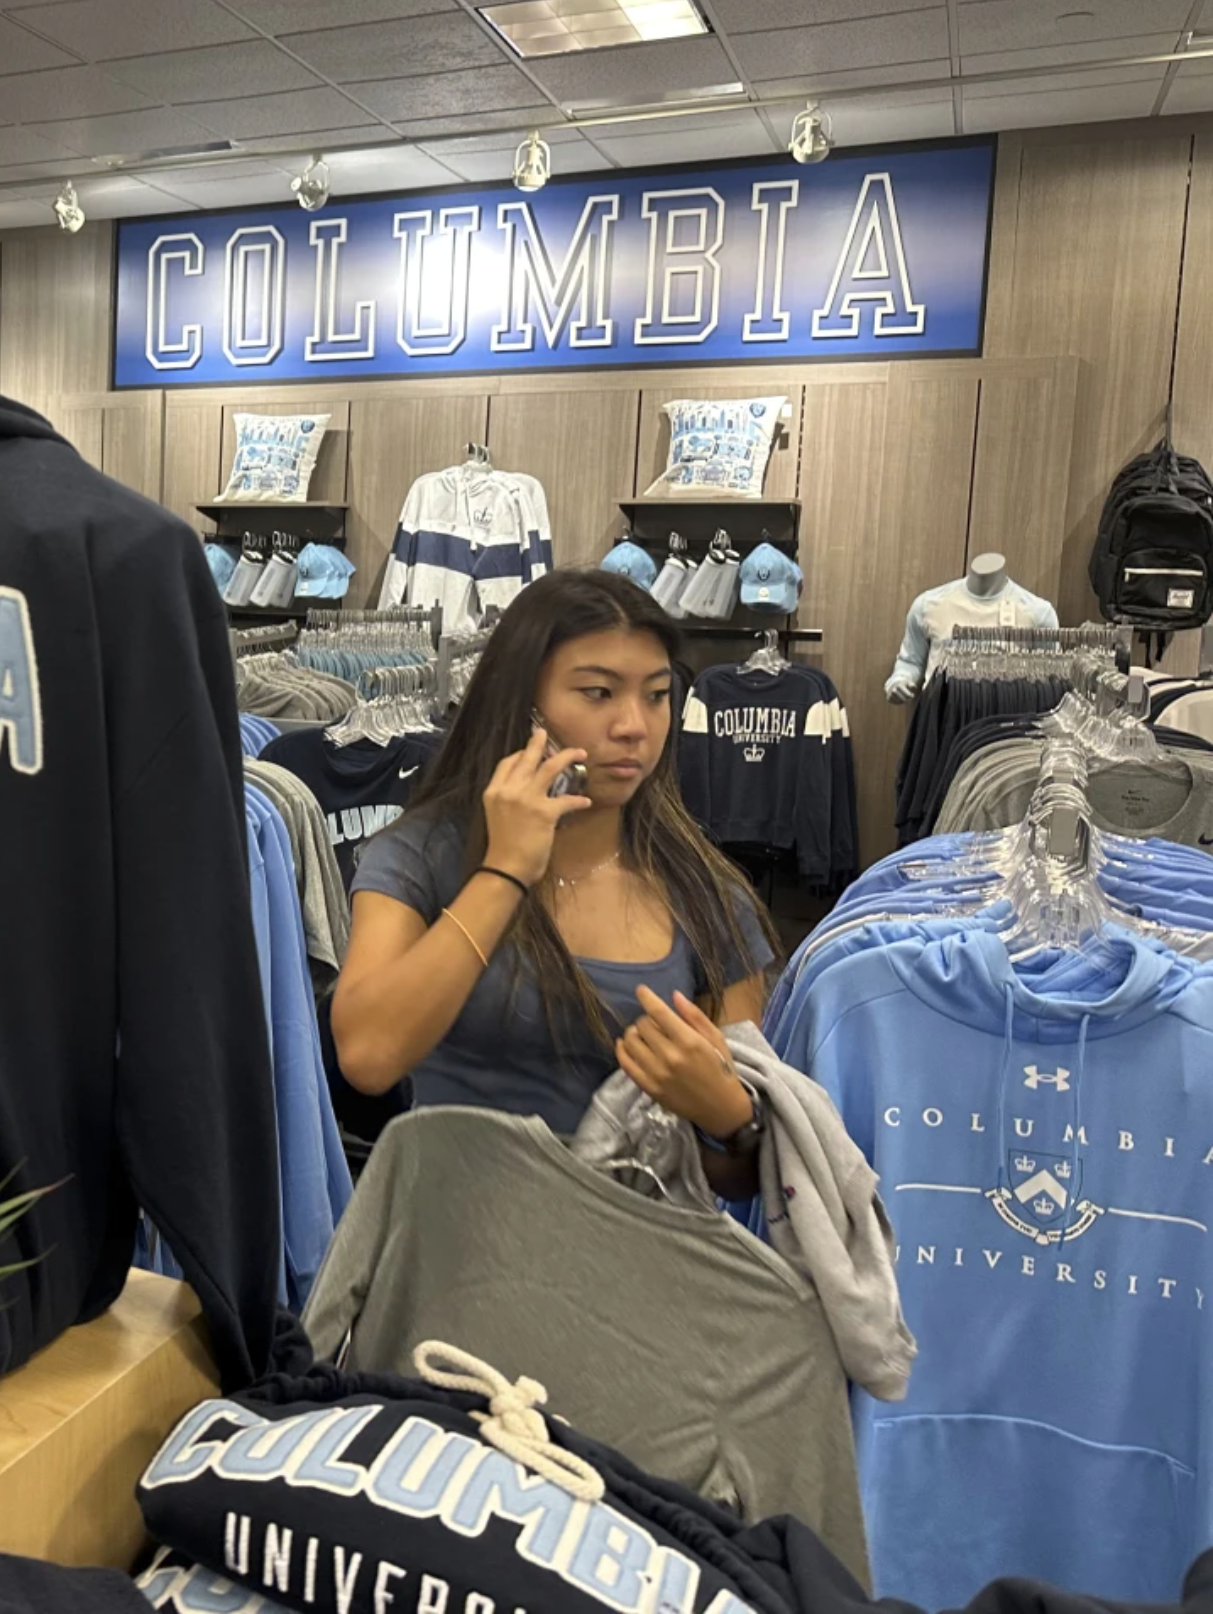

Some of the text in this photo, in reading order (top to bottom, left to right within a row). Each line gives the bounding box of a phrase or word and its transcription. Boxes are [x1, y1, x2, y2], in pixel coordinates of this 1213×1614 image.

[145, 172, 926, 370] COLUMBIA
[714, 706, 797, 738] COLUMBIA
[732, 733, 783, 745] UNIVERSITY
[894, 1245, 1205, 1310] NIVERSITY
[139, 1398, 760, 1614] COLUMBI
[224, 1511, 527, 1614] UNIVER
